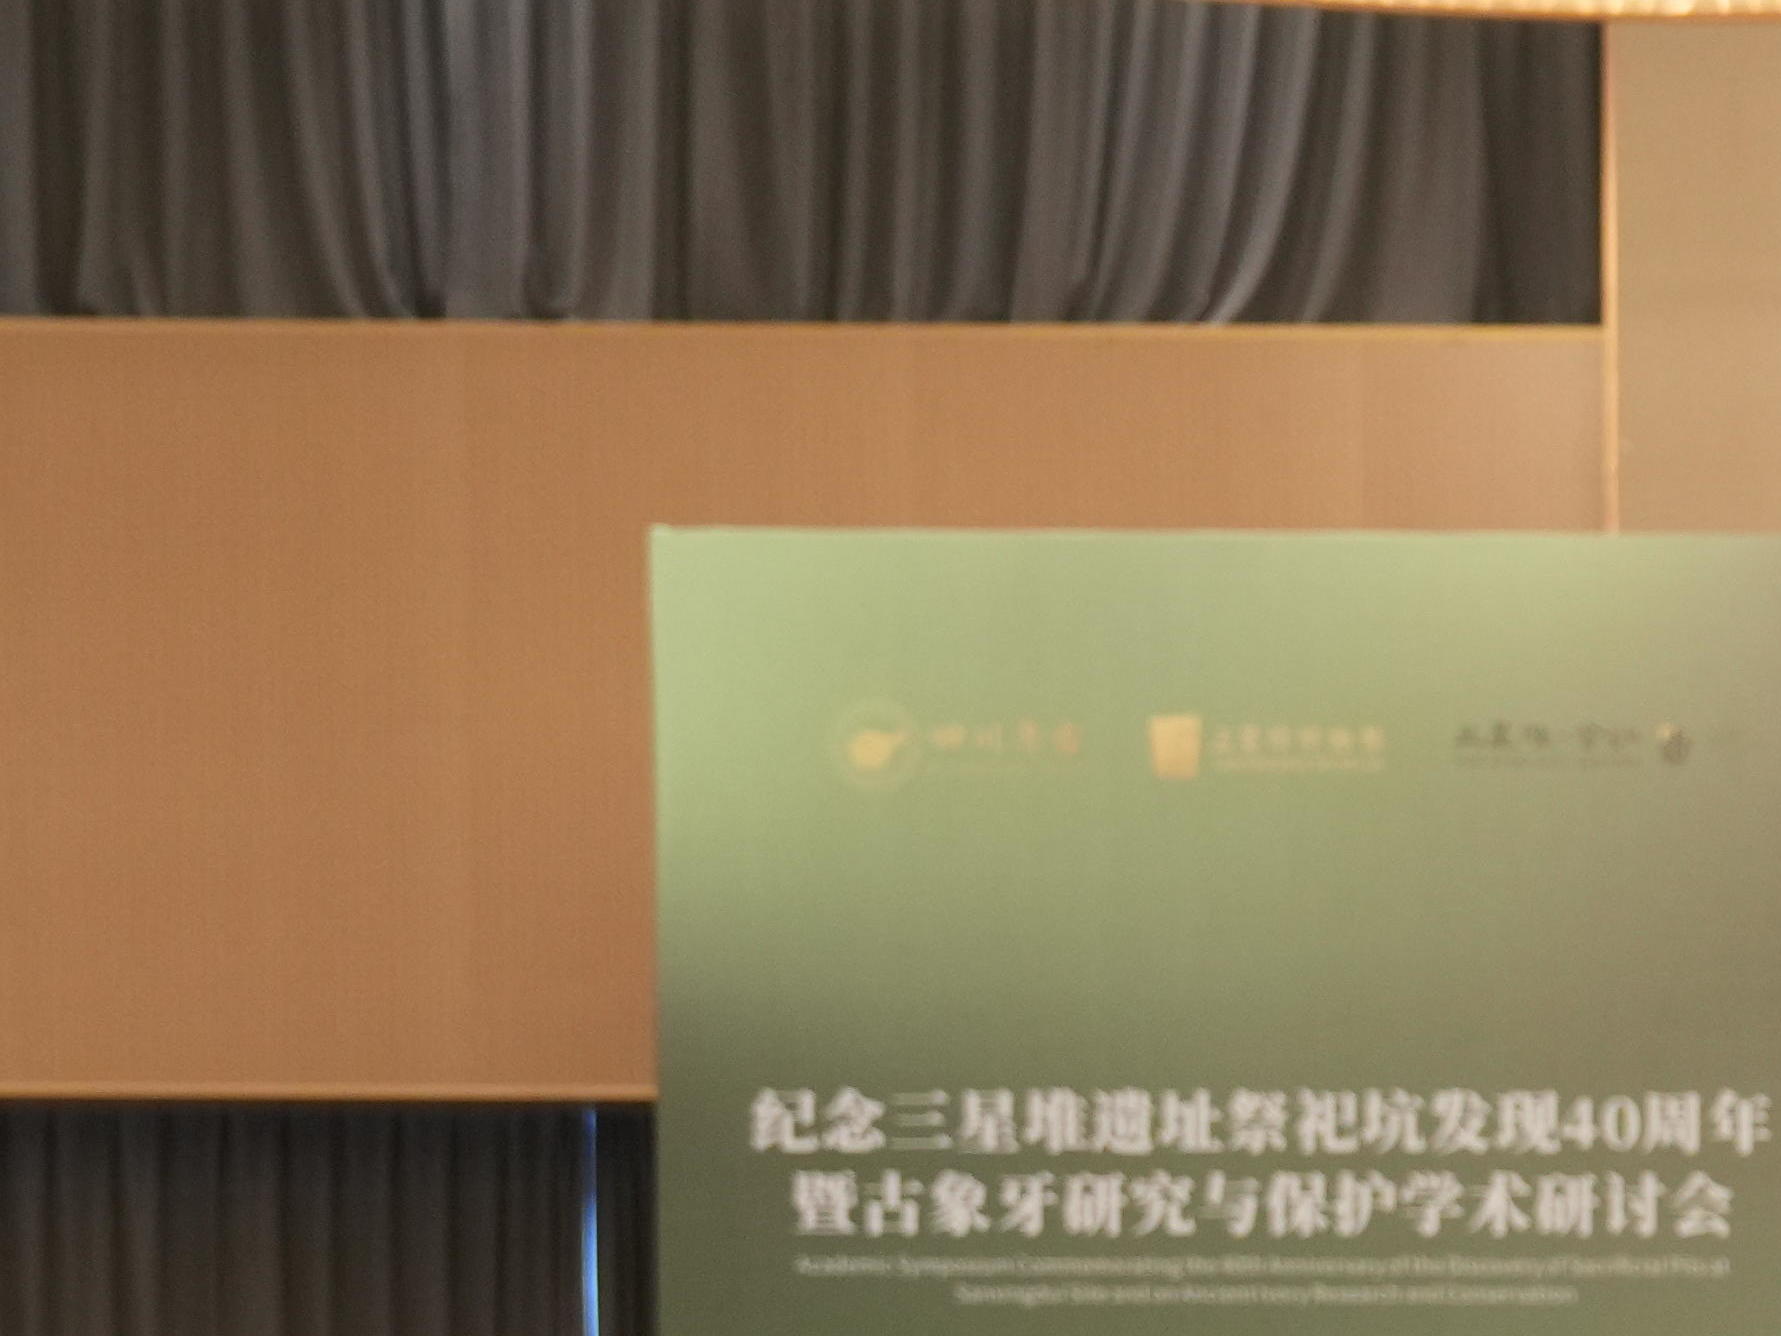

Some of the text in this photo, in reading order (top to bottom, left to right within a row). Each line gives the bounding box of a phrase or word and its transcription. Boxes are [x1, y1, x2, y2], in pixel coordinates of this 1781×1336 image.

[750, 1084, 1773, 1158] 纪念三星堆遗址祭祀坑发现40周年
[791, 1168, 1734, 1240] 暨古象牙研究与保护学术研讨会
